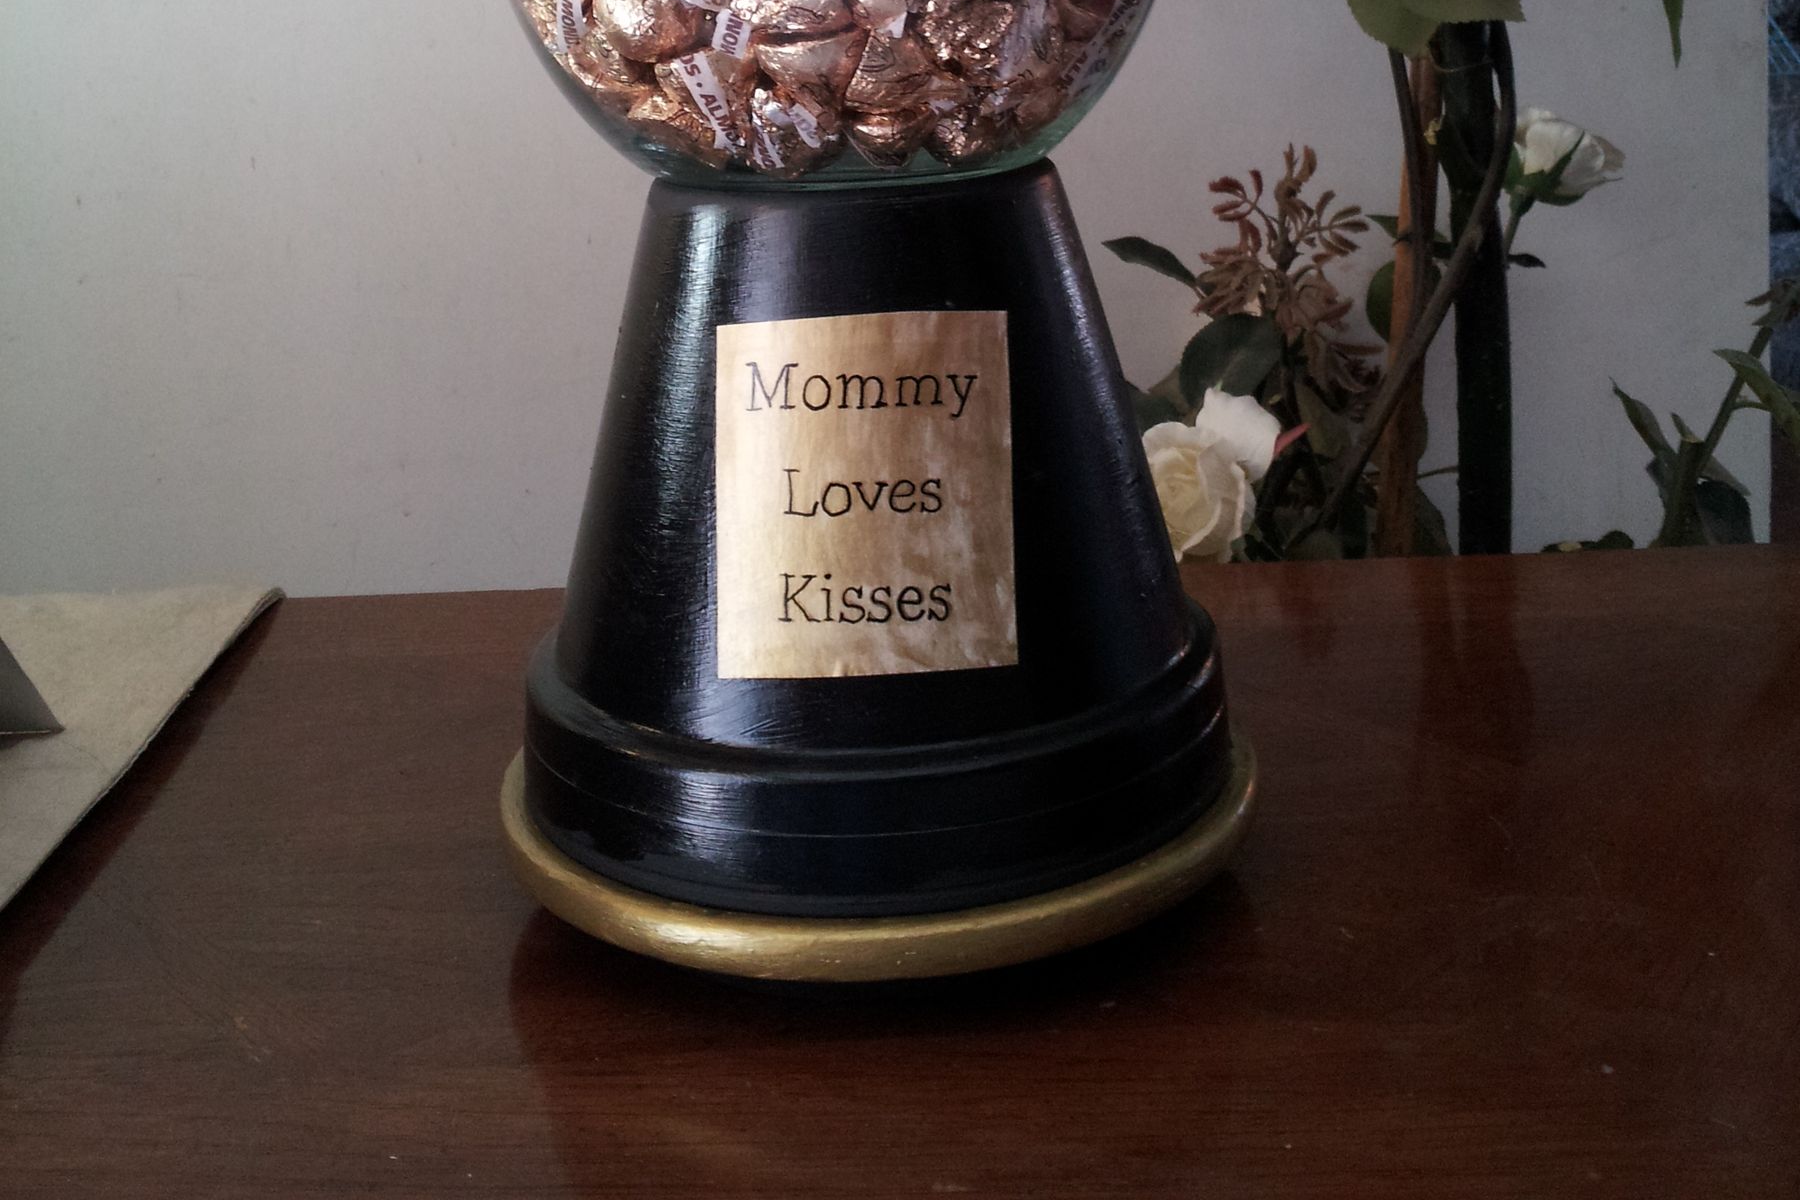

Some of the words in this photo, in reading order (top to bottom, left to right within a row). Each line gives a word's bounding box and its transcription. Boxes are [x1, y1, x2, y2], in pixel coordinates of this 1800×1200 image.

[745, 360, 979, 419] Mommy
[782, 468, 944, 518] Loves
[777, 572, 952, 625] Kisses
